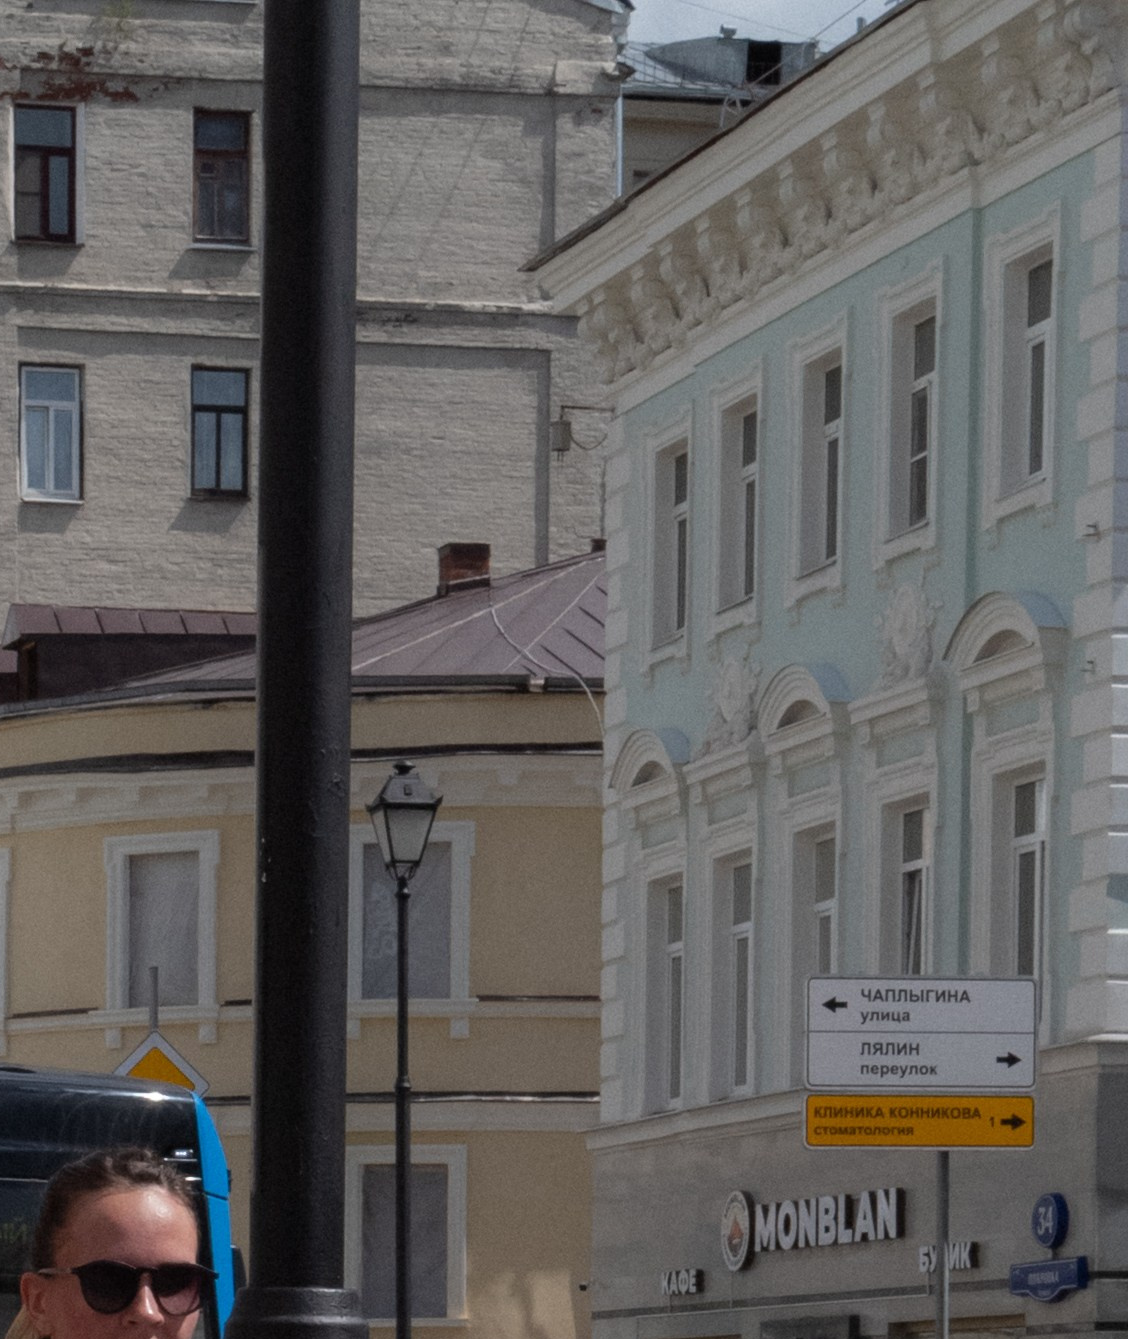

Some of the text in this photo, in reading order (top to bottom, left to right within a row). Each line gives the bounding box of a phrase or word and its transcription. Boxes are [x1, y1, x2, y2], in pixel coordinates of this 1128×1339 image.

[860, 988, 971, 1003] ЧАПЛЫГИНА
[860, 1010, 911, 1025] улица
[860, 1042, 920, 1056] ЛЯЛИН
[860, 1064, 938, 1078] переулок
[813, 1106, 885, 1119] КЛИНИКА
[889, 1107, 982, 1120] КОННИКОВА
[813, 1125, 915, 1136] стоматология
[754, 1187, 898, 1252] MONBLAN
[1037, 1206, 1054, 1236] 34
[919, 1241, 971, 1273] БУИК
[661, 1268, 697, 1296] КАФЕ
